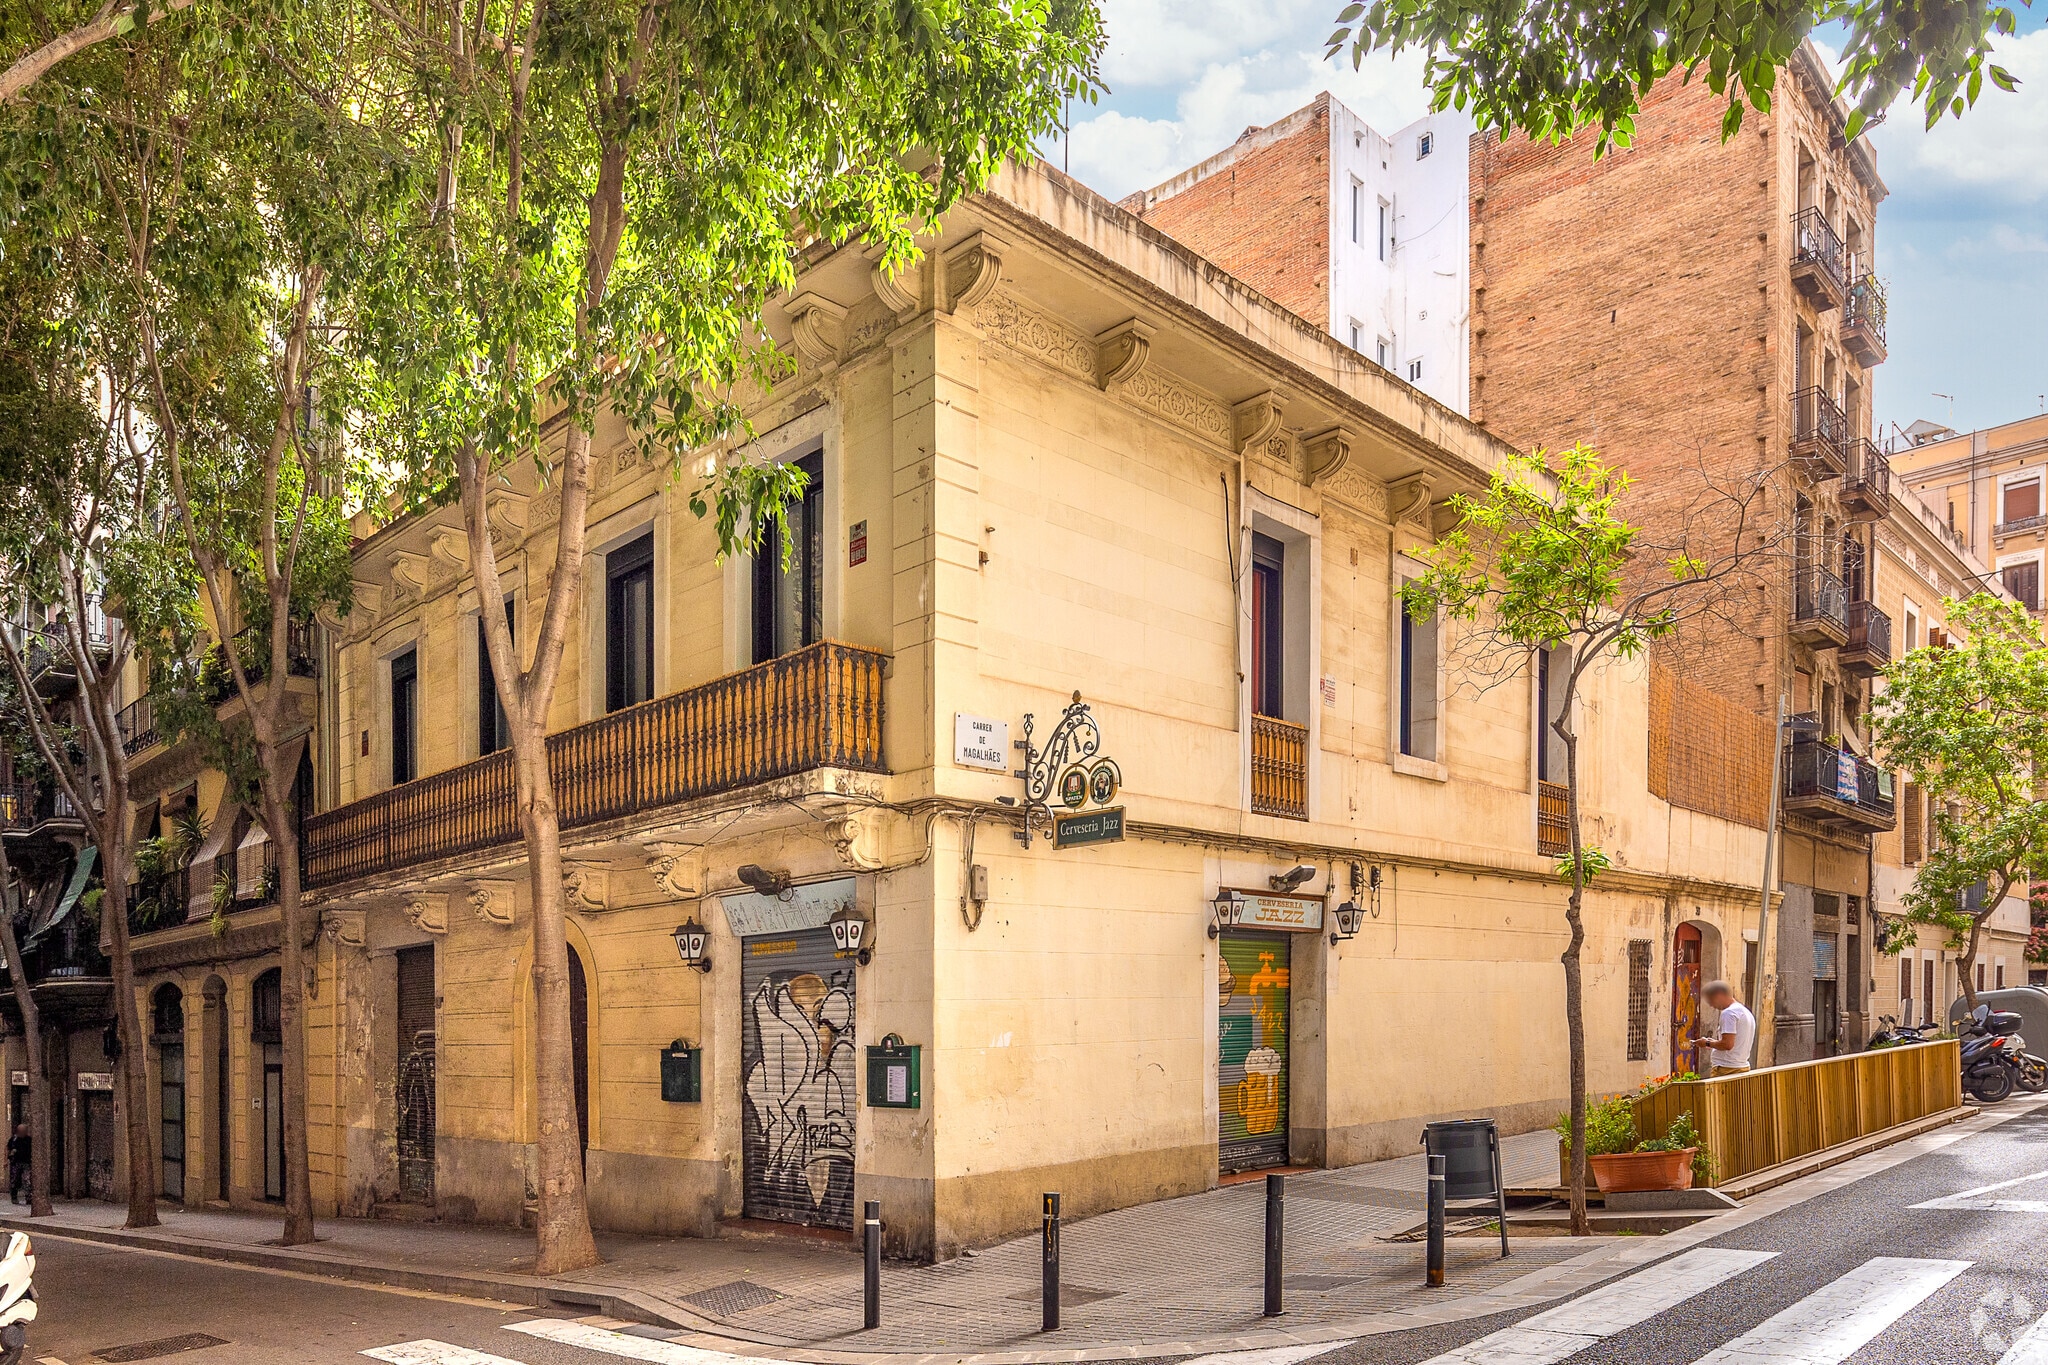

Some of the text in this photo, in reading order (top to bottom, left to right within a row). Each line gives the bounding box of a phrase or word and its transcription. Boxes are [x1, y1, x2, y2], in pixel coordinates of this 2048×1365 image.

[972, 721, 993, 733] CARRER
[978, 735, 986, 745] DE
[963, 746, 1001, 763] MAGALHÃES
[1060, 816, 1119, 836] Cerveseria Jazz
[1257, 898, 1304, 910] CERVESERIA
[1255, 907, 1305, 924] JAZZ
